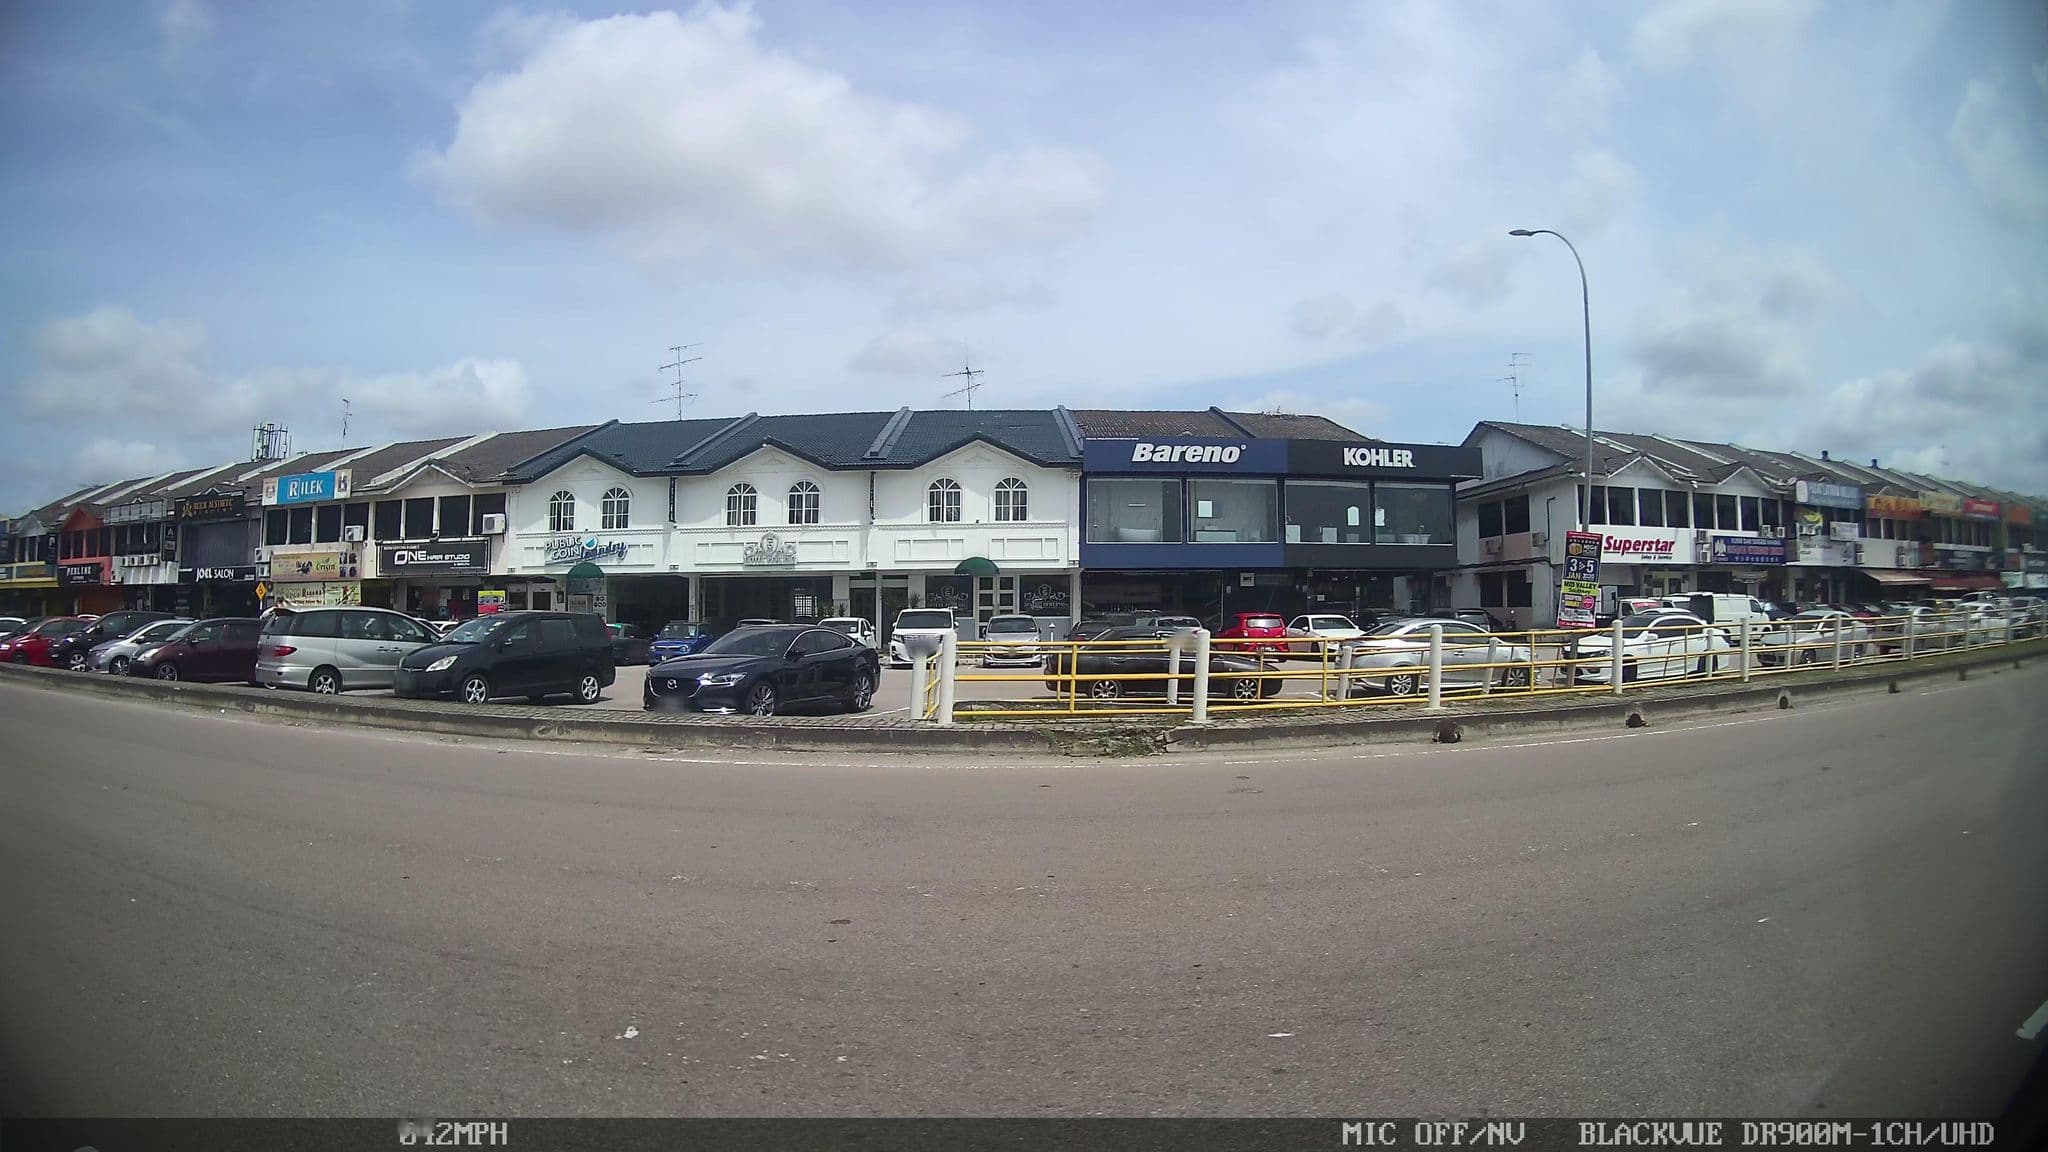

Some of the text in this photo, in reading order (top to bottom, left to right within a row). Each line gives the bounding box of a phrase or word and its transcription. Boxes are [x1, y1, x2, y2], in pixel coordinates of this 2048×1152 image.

[1132, 443, 1240, 463] Bareno
[1343, 447, 1416, 467] KOHLER
[289, 480, 323, 497] RILEK
[545, 536, 582, 551] PUBLIC
[1604, 535, 1675, 555] Superstar
[394, 550, 427, 565] ONE
[552, 546, 580, 559] COIN
[1570, 558, 1595, 573] 3 5
[196, 568, 212, 582] JOEL
[213, 568, 234, 580] SALON
[1567, 572, 1580, 580] JAN
